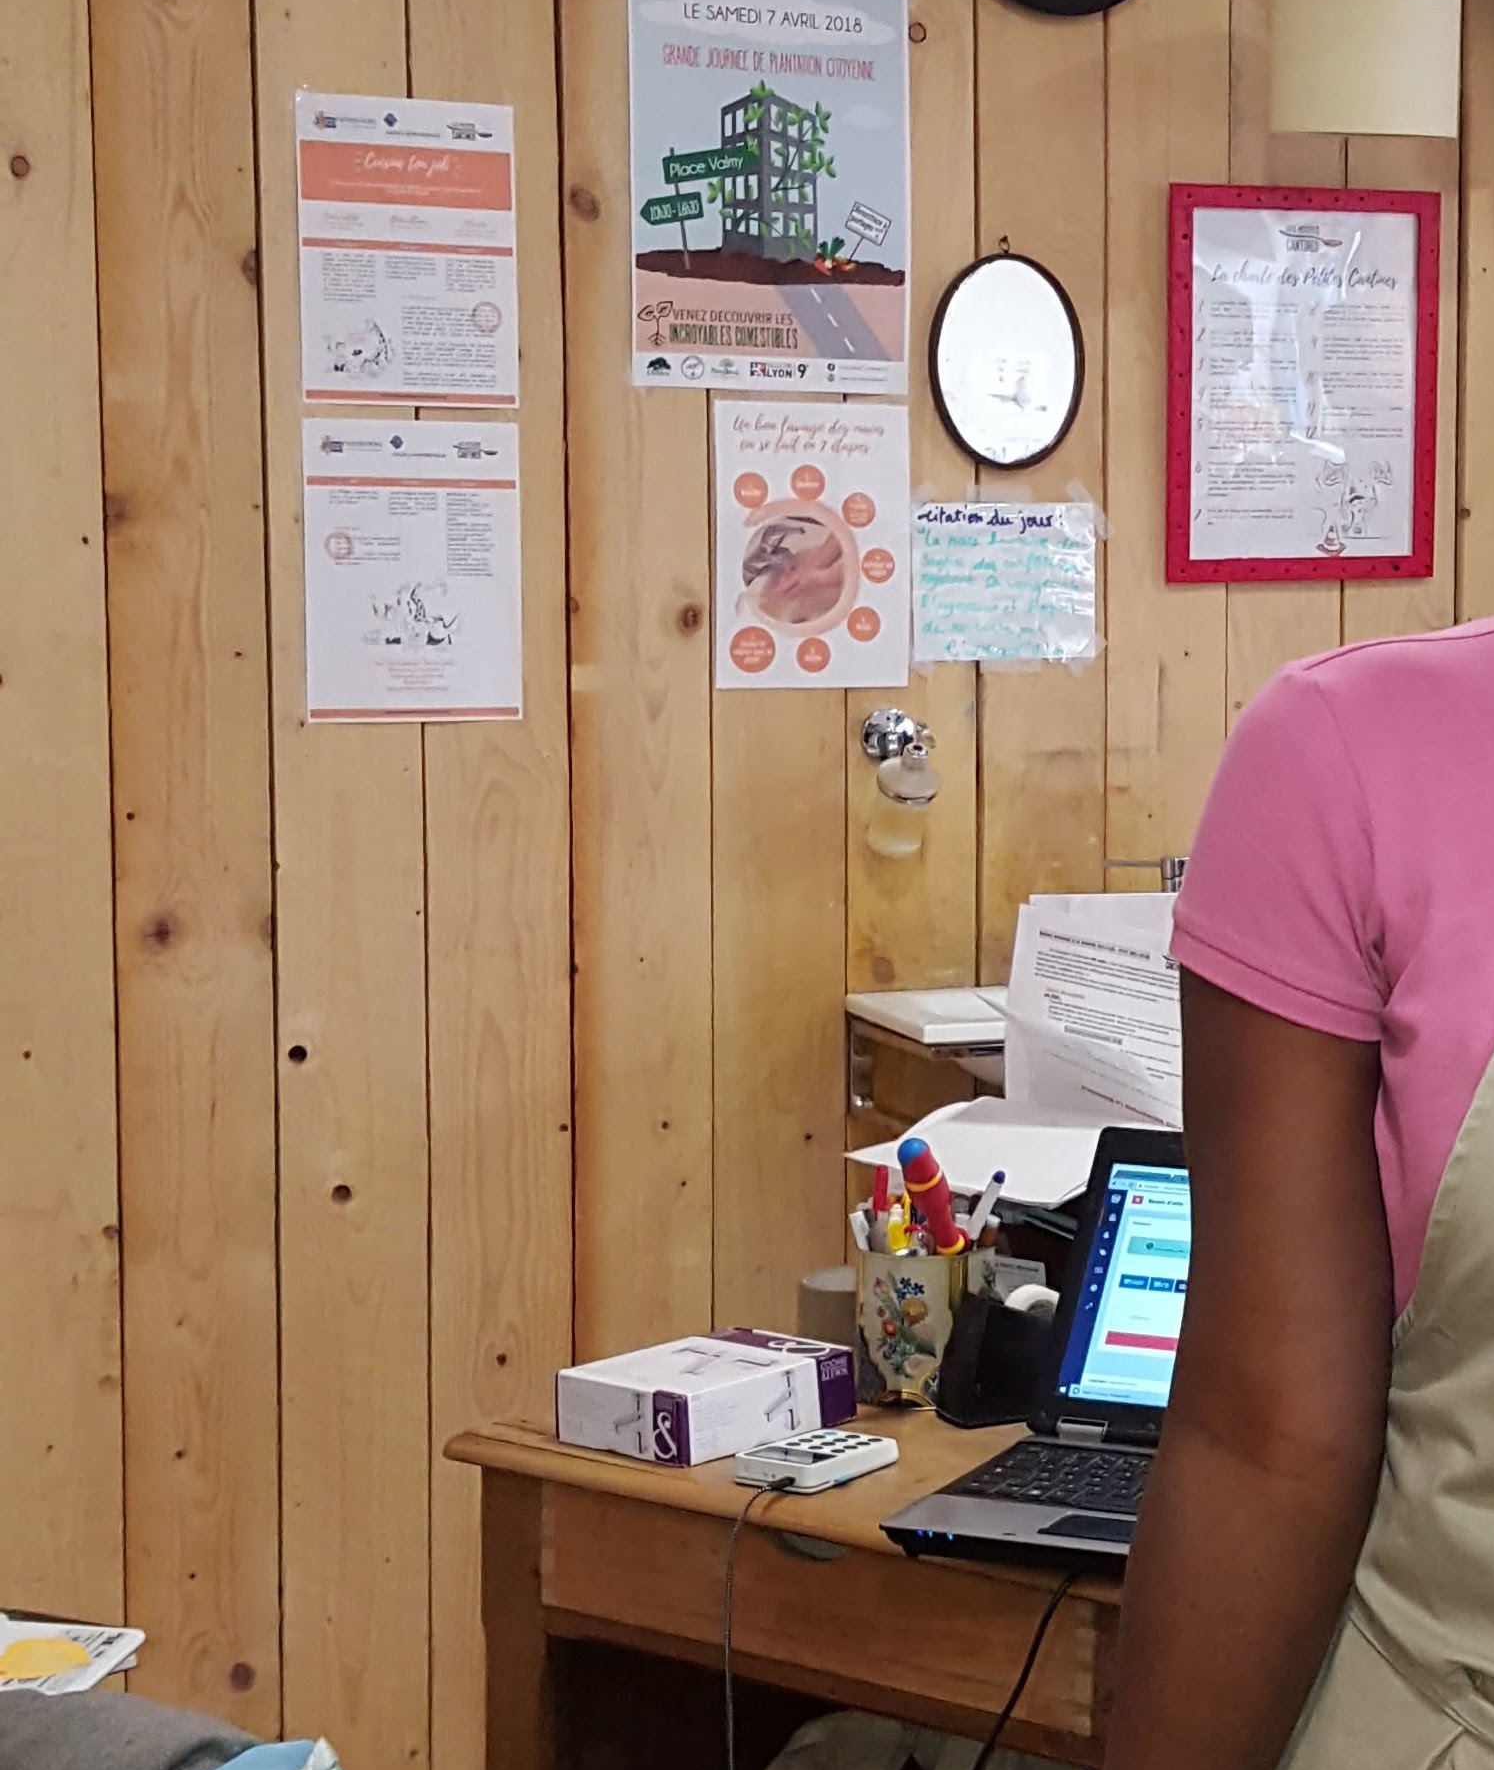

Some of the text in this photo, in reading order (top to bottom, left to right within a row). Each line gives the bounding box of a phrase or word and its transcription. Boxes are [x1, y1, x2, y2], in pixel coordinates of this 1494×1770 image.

[684, 3, 863, 34] LE SAMEDI 7 AVRIL 2018
[753, 50, 765, 73] DE
[669, 155, 744, 177] Place Valmy
[673, 309, 707, 322] VENEZ
[775, 313, 793, 326] LES
[767, 368, 793, 378] LYON
[987, 509, 1013, 527] du
